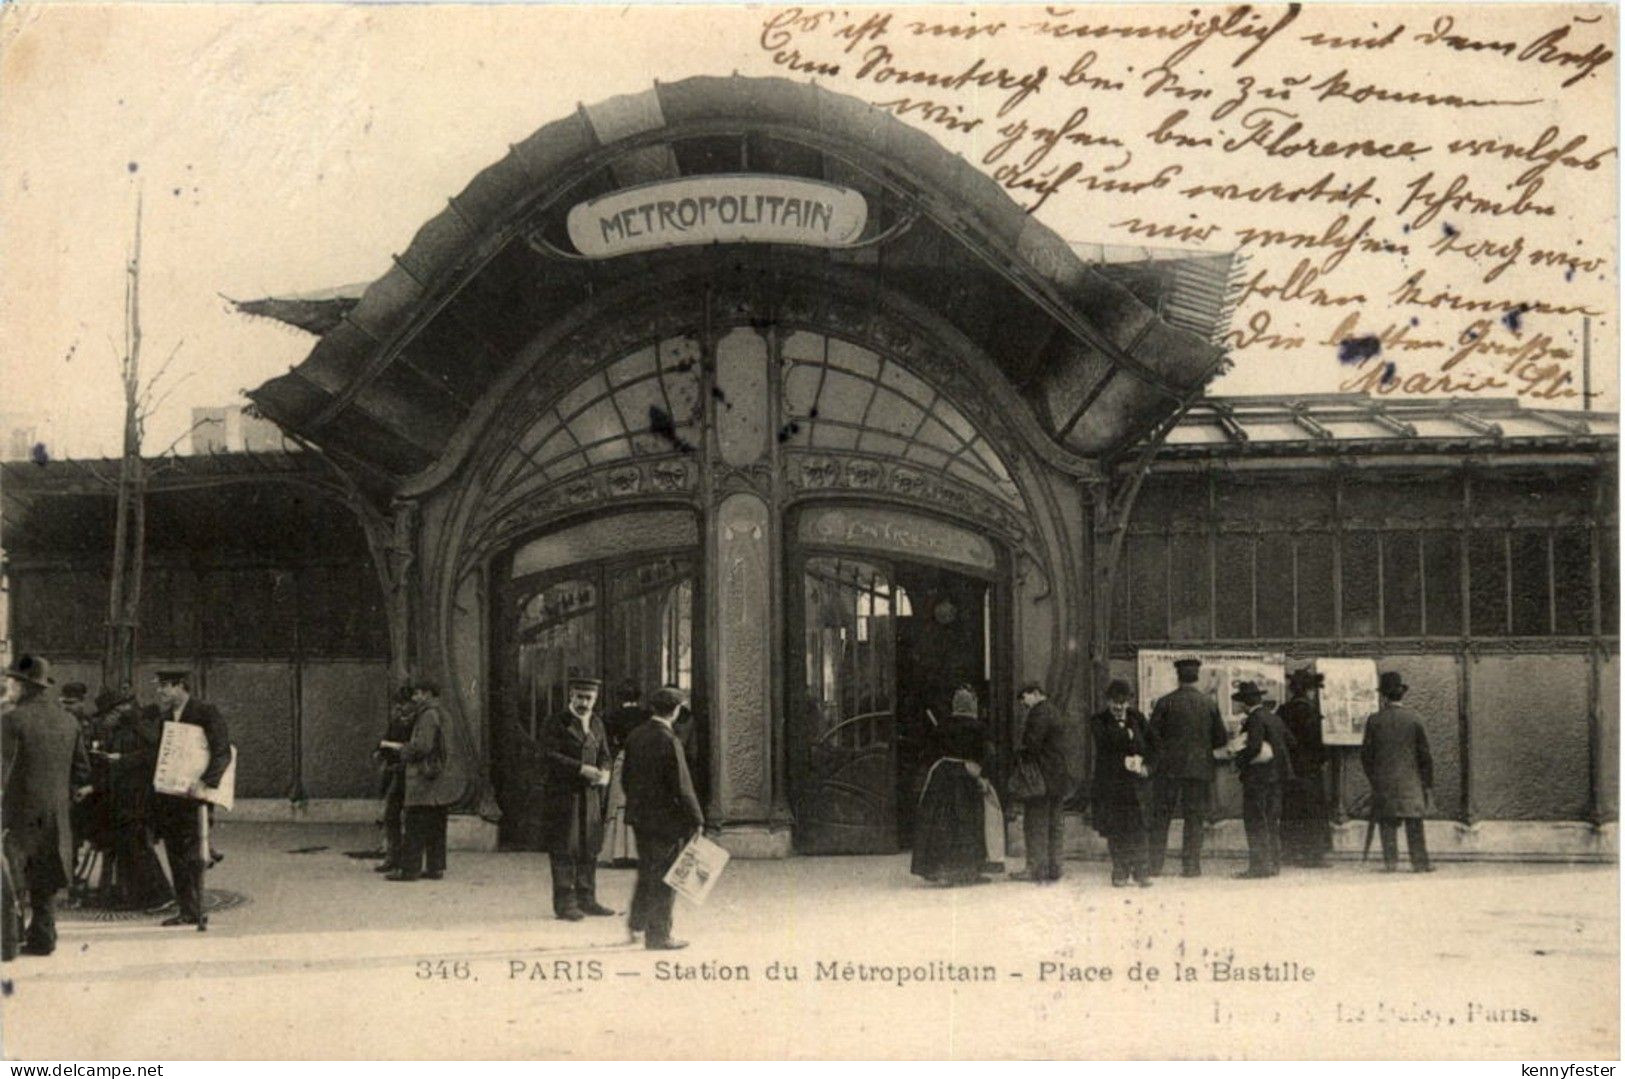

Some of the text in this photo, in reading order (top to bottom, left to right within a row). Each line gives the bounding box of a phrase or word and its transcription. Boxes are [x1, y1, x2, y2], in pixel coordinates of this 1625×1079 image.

[600, 196, 833, 243] METROPOLITAIN
[415, 961, 478, 981] 346.
[508, 961, 603, 981] PARIS
[655, 960, 750, 981] Station
[765, 961, 798, 981] du
[815, 960, 996, 987] Métropolitain
[1038, 961, 1112, 982] Place
[1127, 961, 1159, 982] de
[1174, 961, 1198, 982] la
[1212, 961, 1315, 982] Bastille
